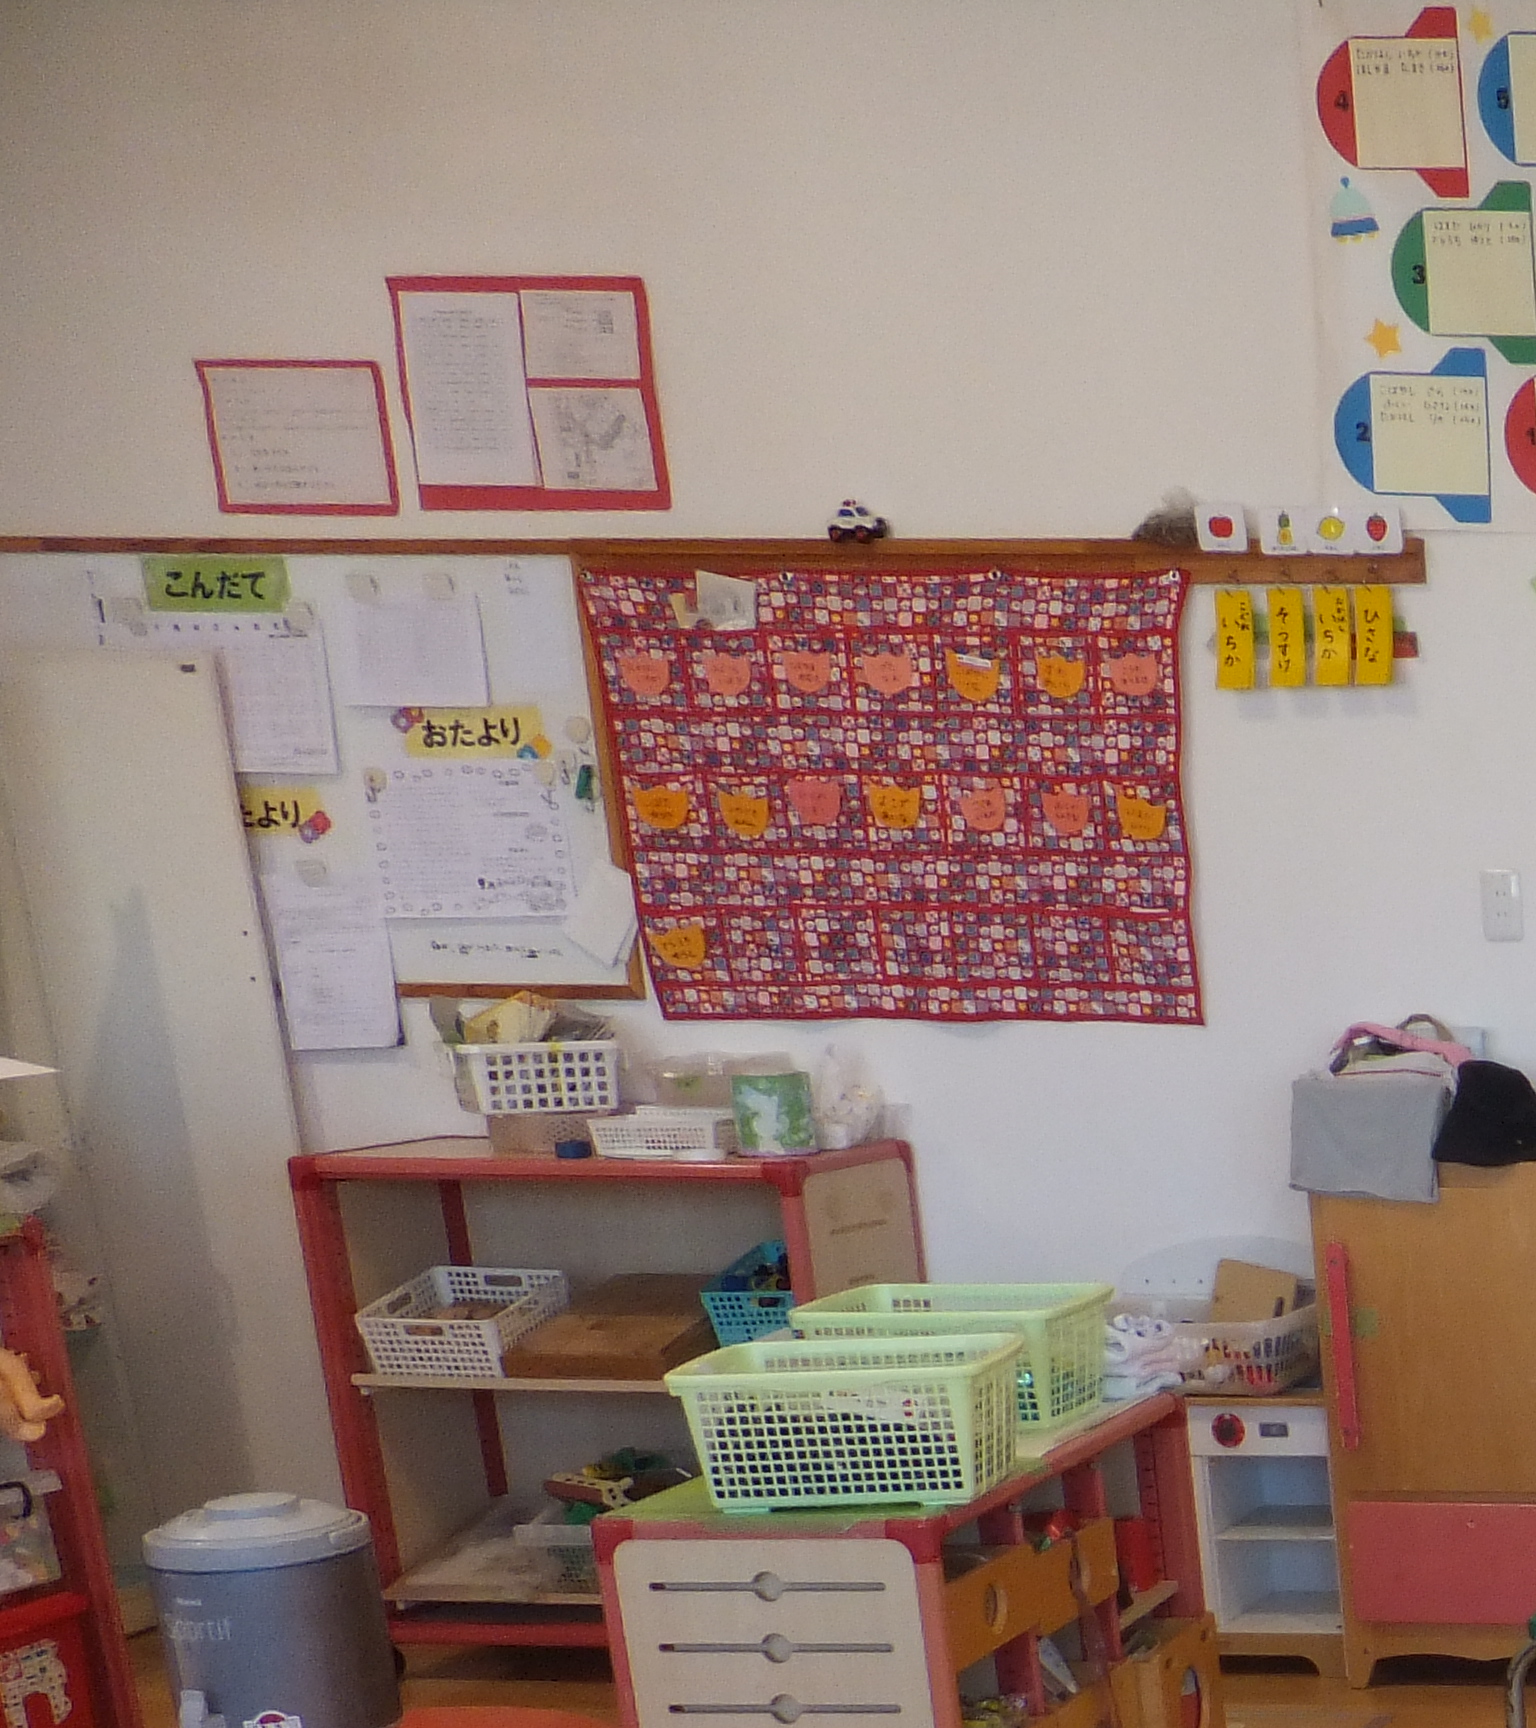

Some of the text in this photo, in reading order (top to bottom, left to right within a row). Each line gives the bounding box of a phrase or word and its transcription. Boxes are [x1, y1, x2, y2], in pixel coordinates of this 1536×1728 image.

[1335, 90, 1349, 110] 4
[1412, 264, 1426, 285] 3
[1356, 422, 1370, 442] 2
[165, 571, 265, 599] こんだて
[422, 717, 521, 748] おたより
